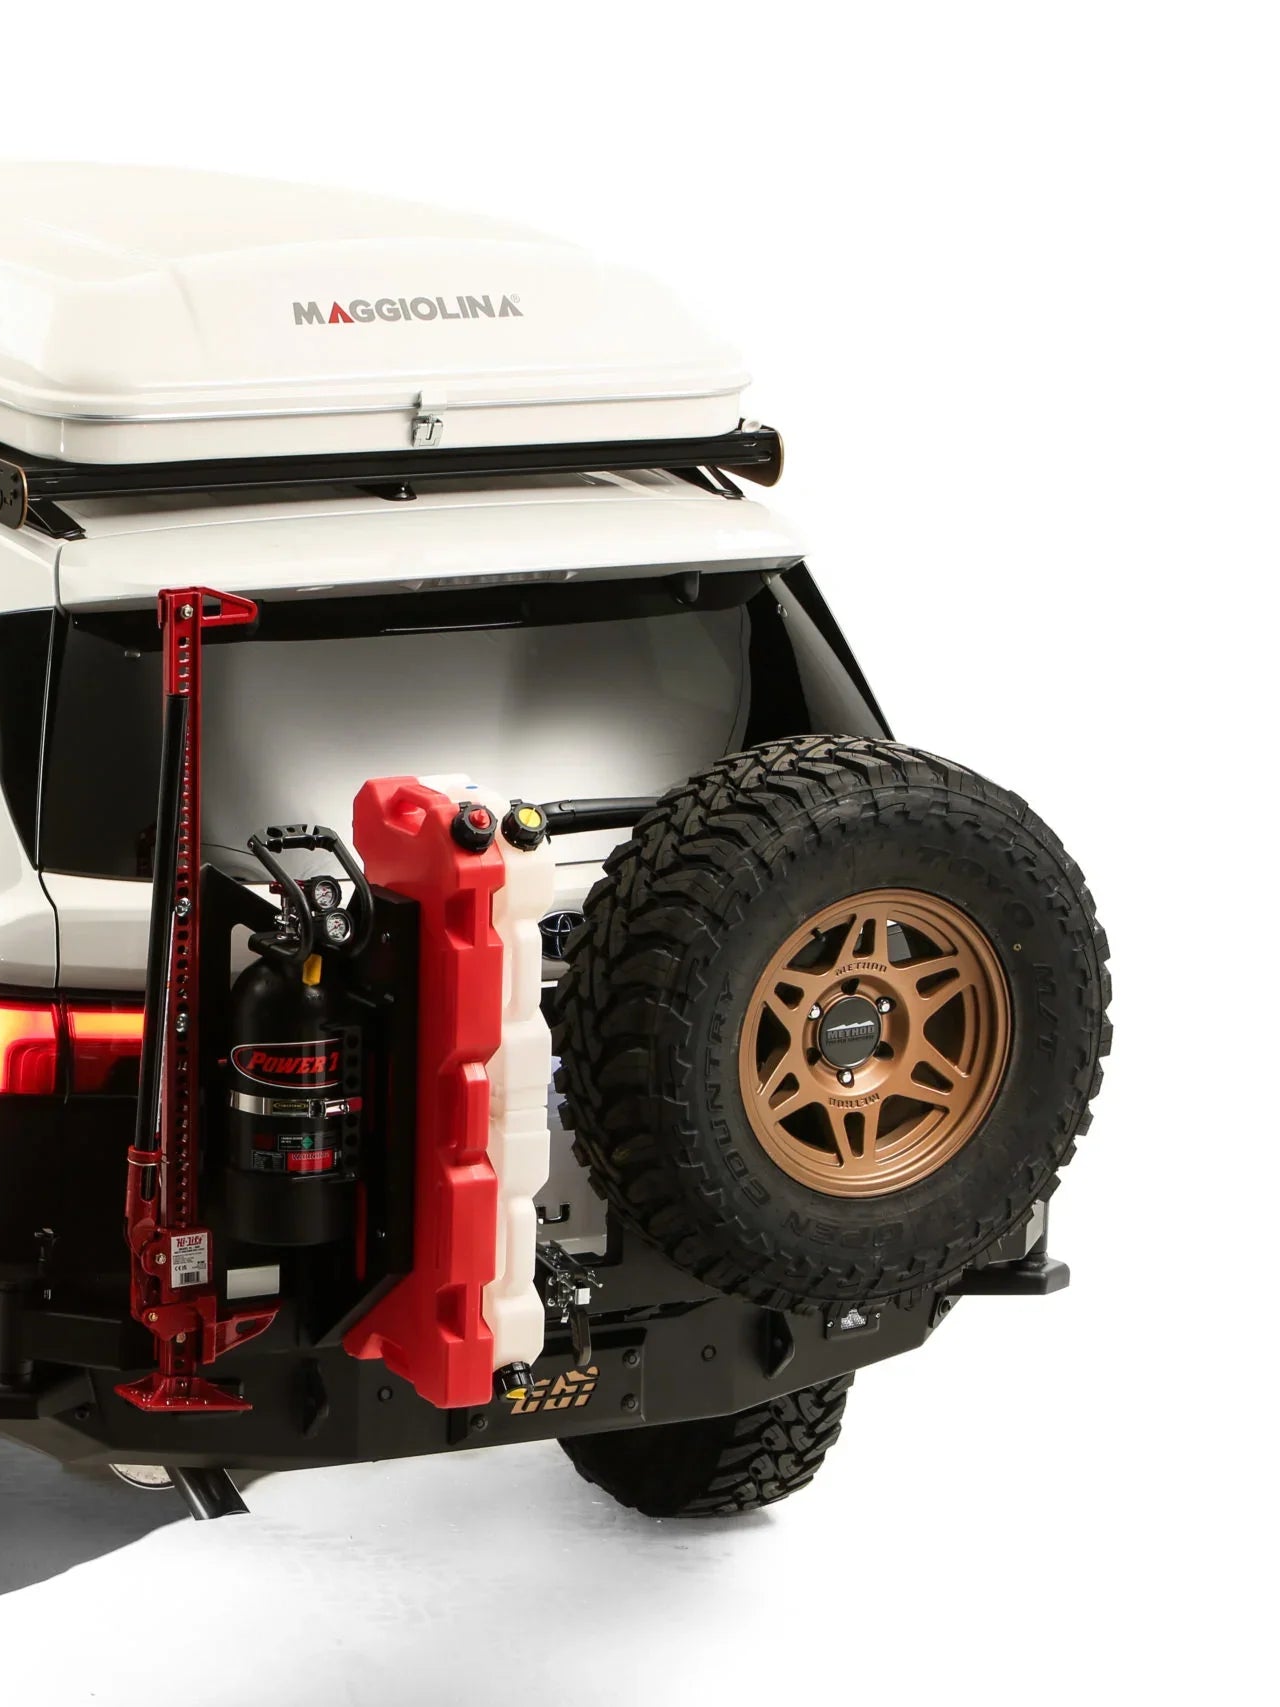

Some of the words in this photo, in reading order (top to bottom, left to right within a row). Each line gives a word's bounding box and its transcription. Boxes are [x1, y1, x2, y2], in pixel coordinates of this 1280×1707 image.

[292, 294, 524, 325] MAGGIOLINA
[827, 1026, 875, 1040] METHOD
[246, 1051, 327, 1074] POWER
